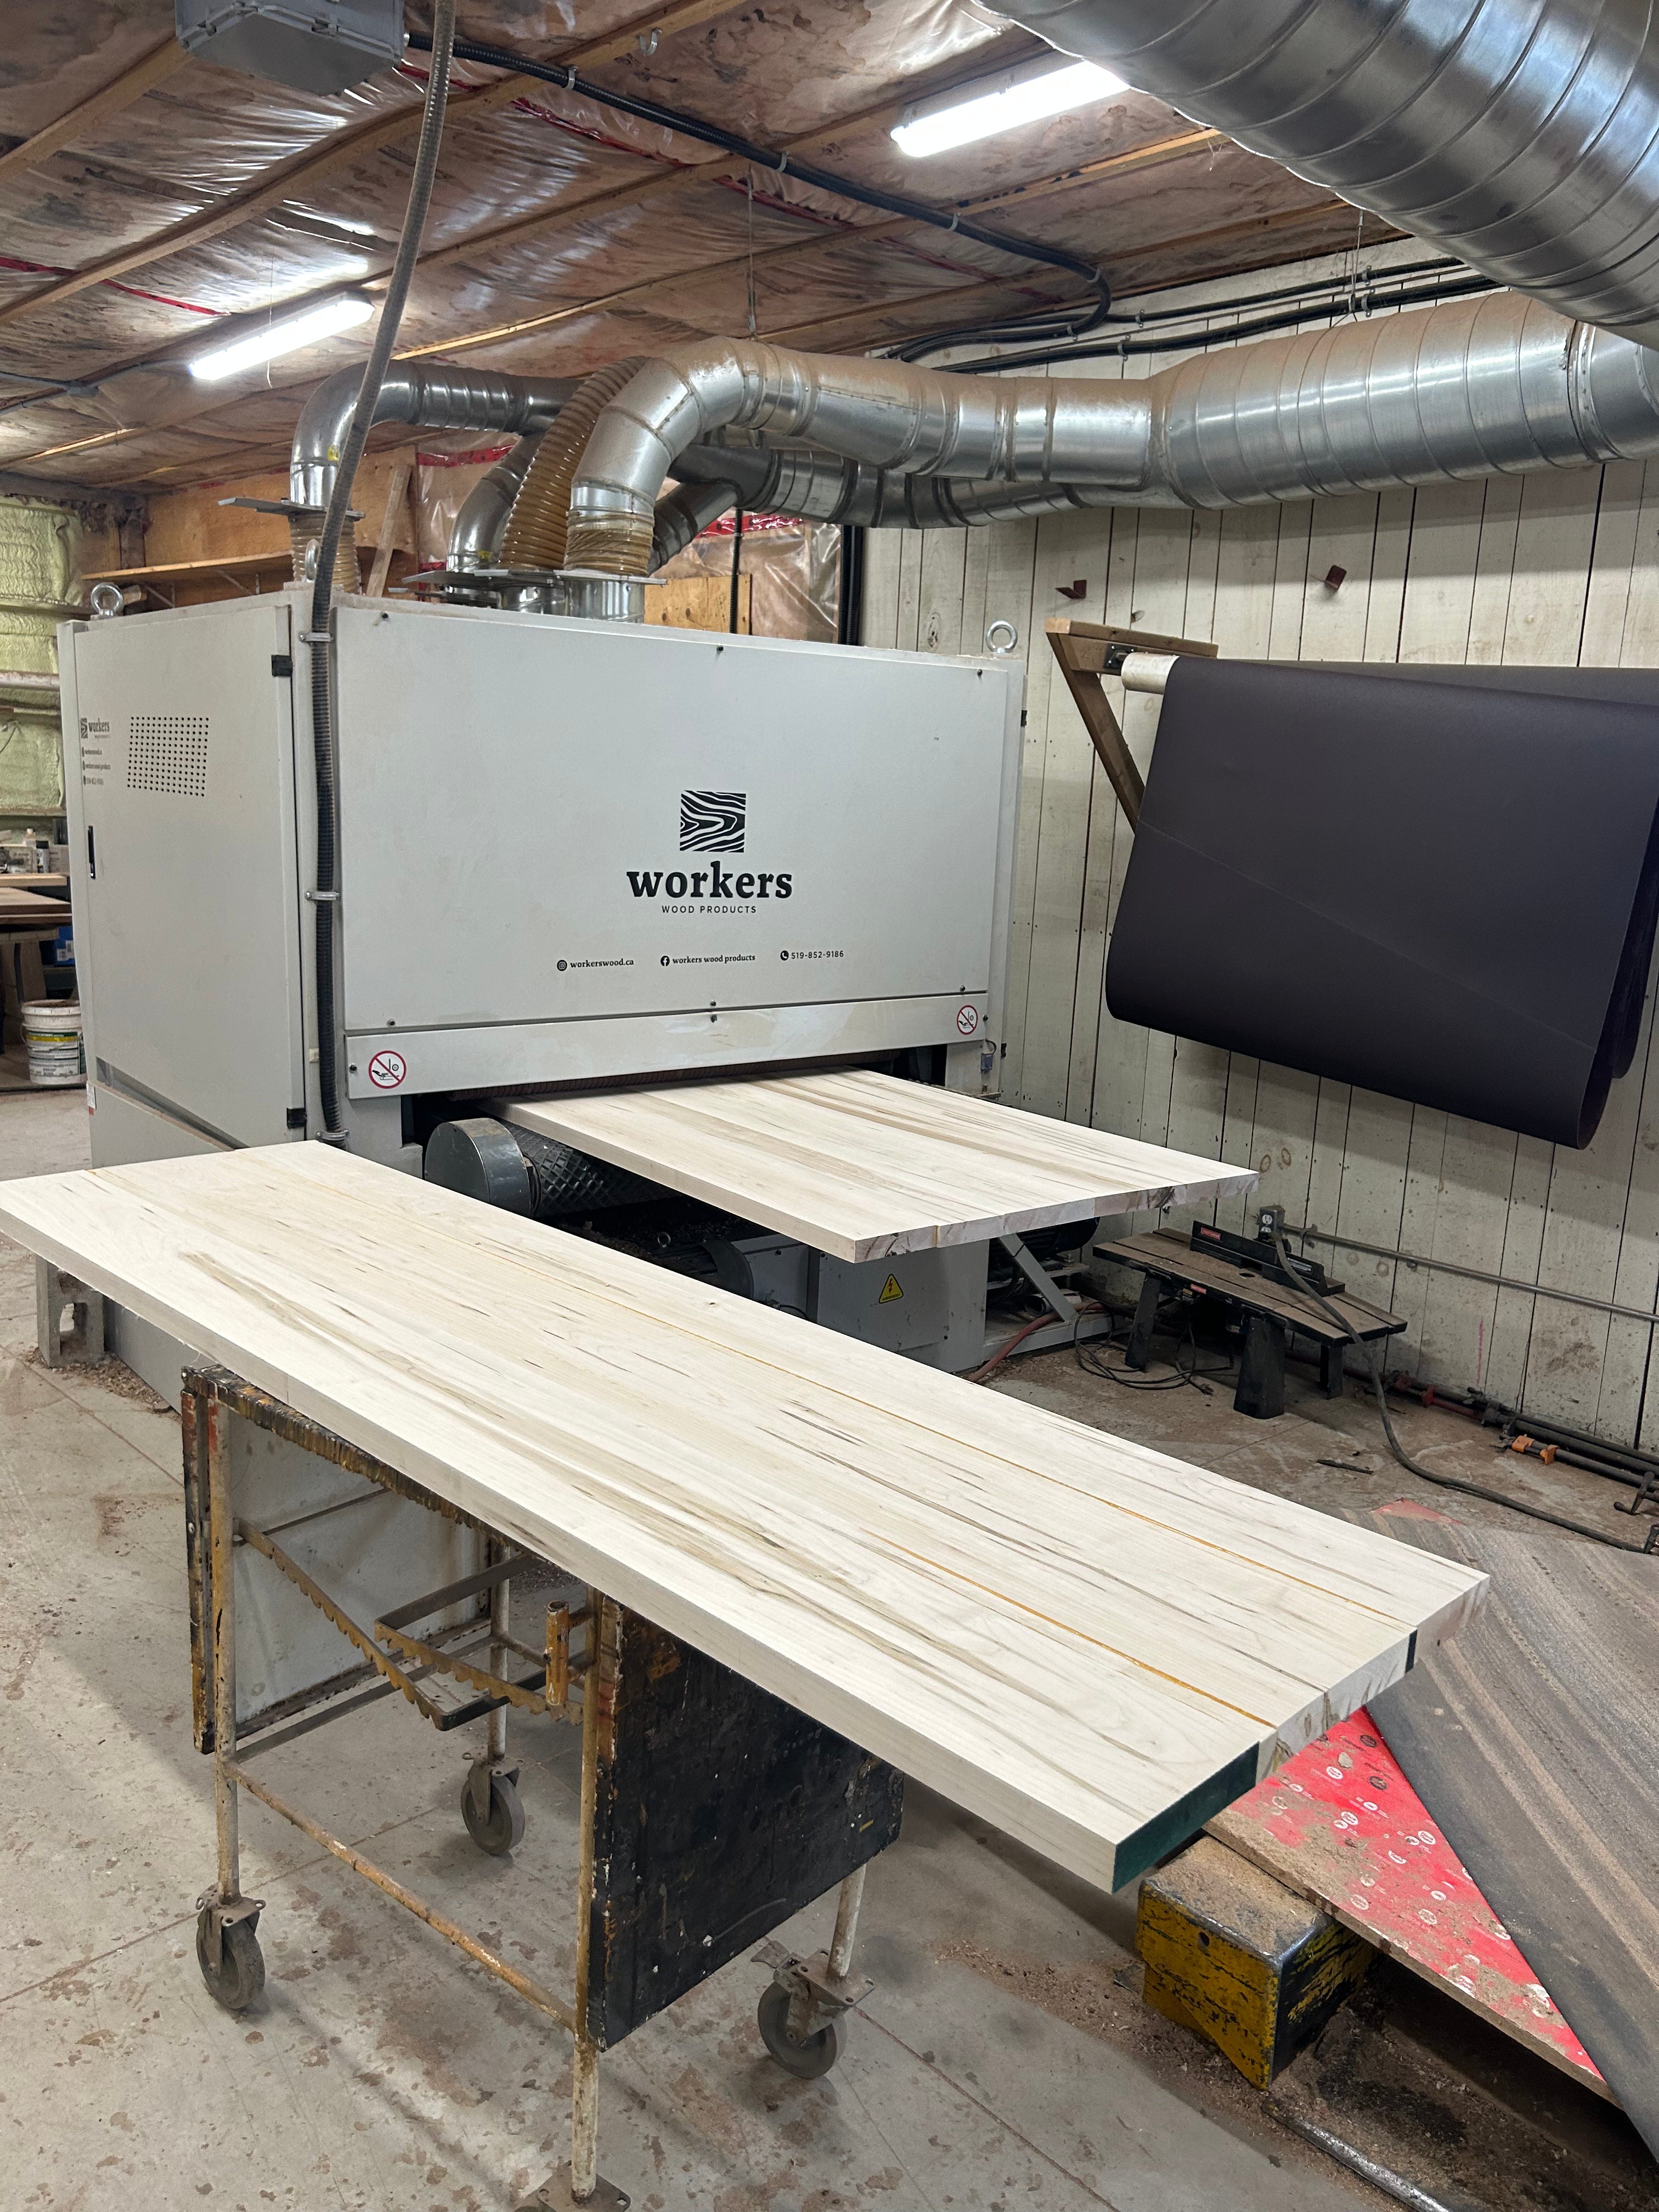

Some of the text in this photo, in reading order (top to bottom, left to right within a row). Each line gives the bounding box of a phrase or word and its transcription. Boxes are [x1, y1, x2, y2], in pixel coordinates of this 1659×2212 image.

[626, 860, 793, 899] workers
[662, 905, 695, 913] WOOD
[724, 954, 756, 964] products
[791, 950, 844, 960] 519-852-9186
[569, 958, 635, 968] workerswood.ca
